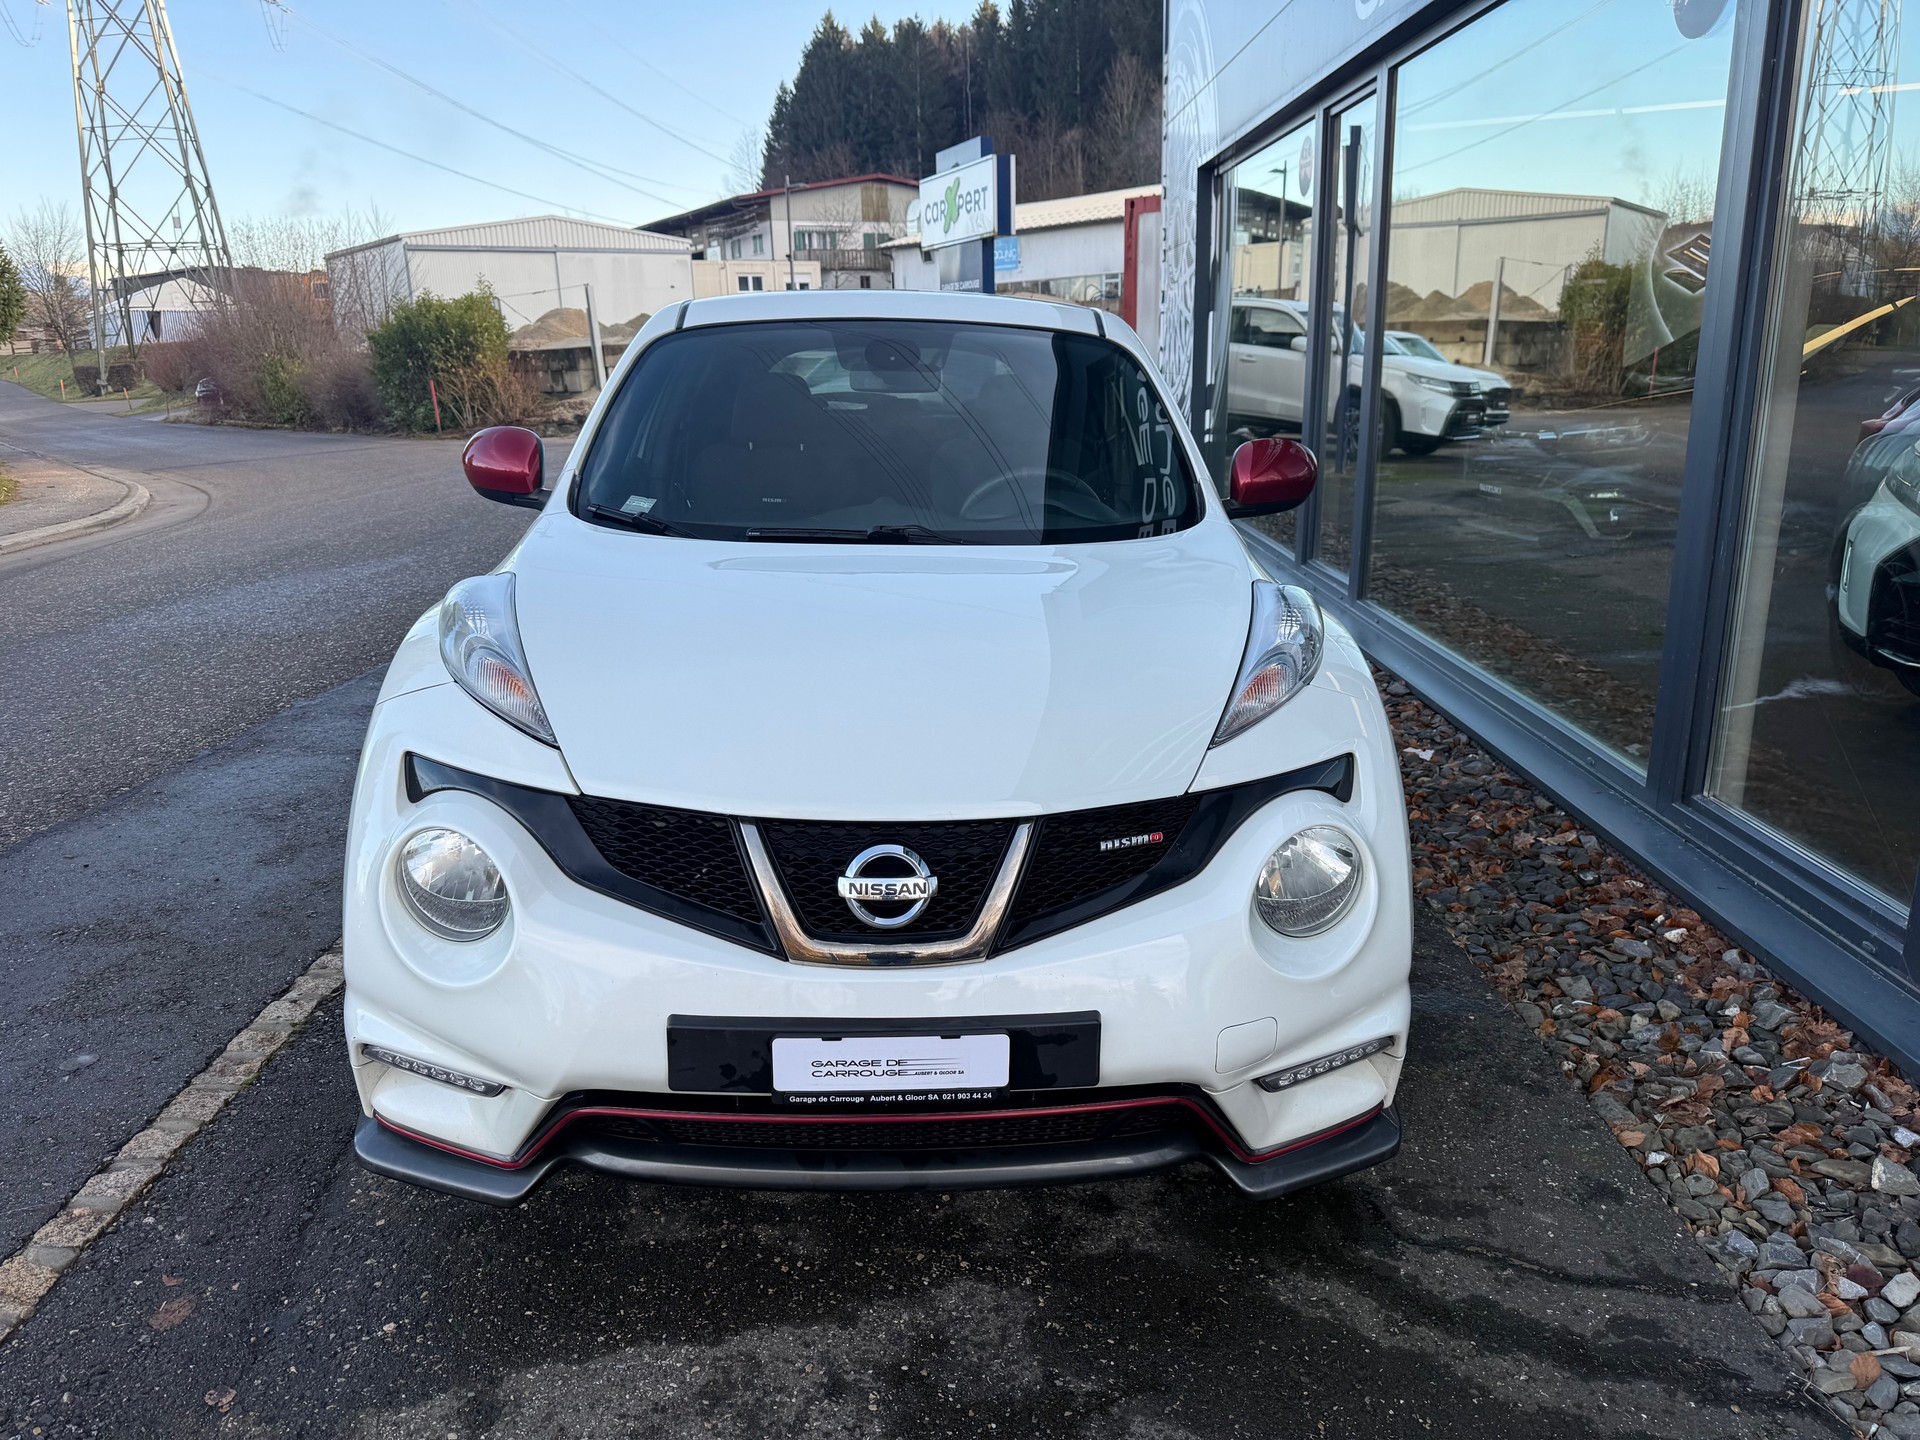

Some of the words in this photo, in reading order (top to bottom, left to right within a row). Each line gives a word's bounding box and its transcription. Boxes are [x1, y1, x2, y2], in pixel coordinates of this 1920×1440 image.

[849, 882, 927, 896] NISSAN
[886, 1059, 908, 1067] DE
[811, 1069, 908, 1077] CARROUGE
[789, 1095, 817, 1103] Garage
[829, 1095, 865, 1103] Carrouge
[870, 1094, 896, 1102] Aubert
[904, 1093, 926, 1101] Gloor
[942, 1092, 955, 1100] 021
